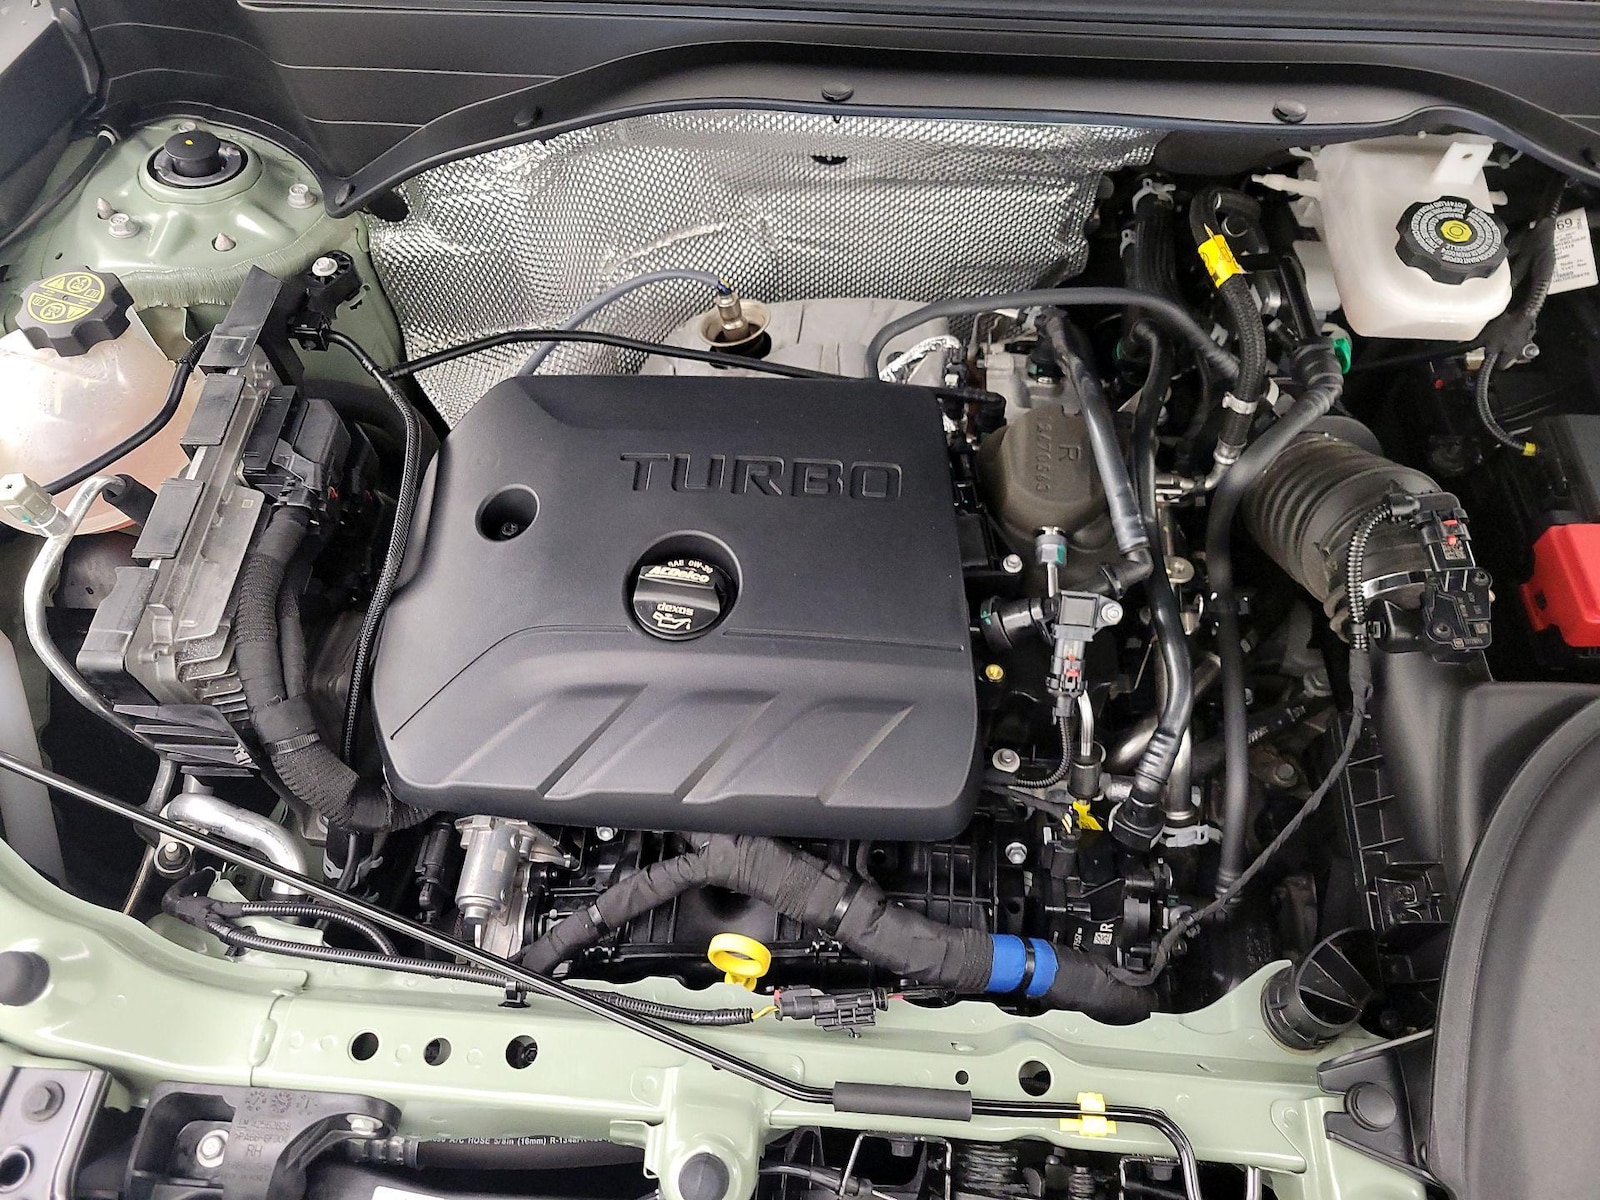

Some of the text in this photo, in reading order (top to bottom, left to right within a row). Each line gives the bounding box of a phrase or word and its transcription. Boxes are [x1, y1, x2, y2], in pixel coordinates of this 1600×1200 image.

[1059, 443, 1081, 462] R
[620, 453, 903, 499] TURBO
[667, 559, 685, 568] SAE
[644, 566, 711, 583] ACDelco
[656, 602, 694, 616] dexos
[1099, 923, 1115, 932] R
[468, 1137, 491, 1145] HOSE
[517, 1137, 547, 1146] (16mm)
[247, 1144, 263, 1157] RH
